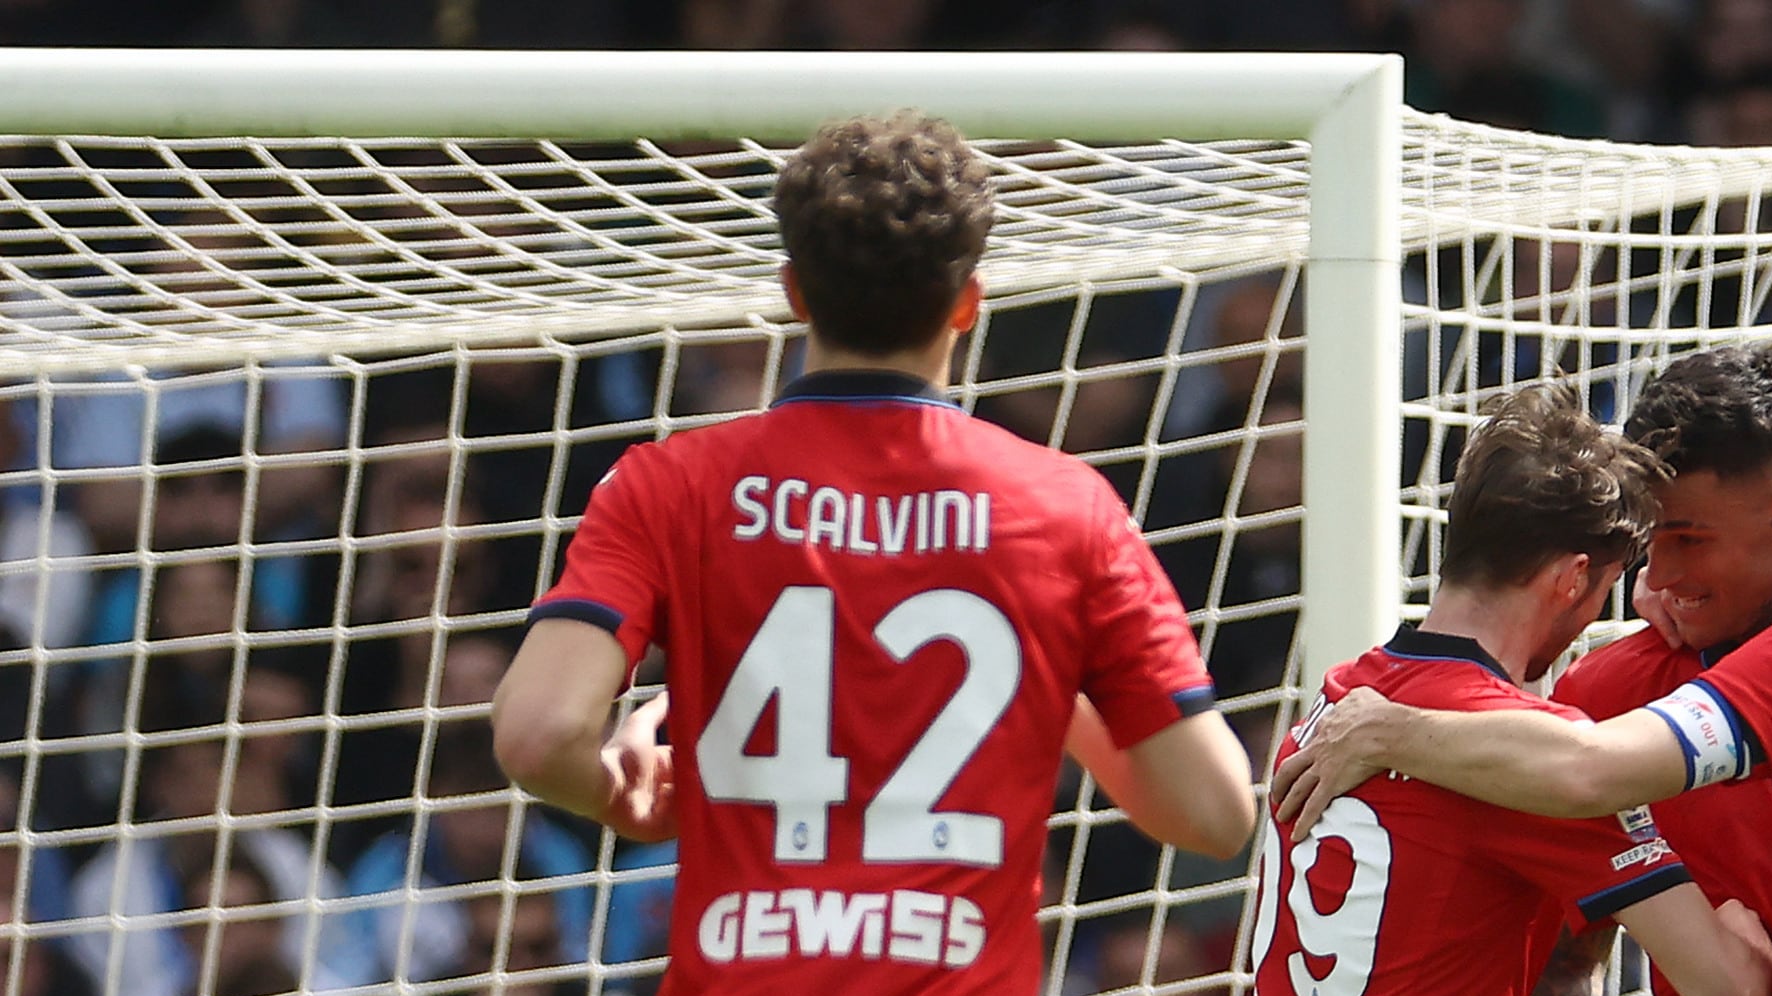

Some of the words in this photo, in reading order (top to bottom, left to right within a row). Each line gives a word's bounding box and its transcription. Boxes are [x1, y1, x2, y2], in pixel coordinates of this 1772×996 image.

[733, 475, 990, 553] SCALVINI
[696, 585, 1023, 868] 42
[698, 889, 987, 969] GEWISS
